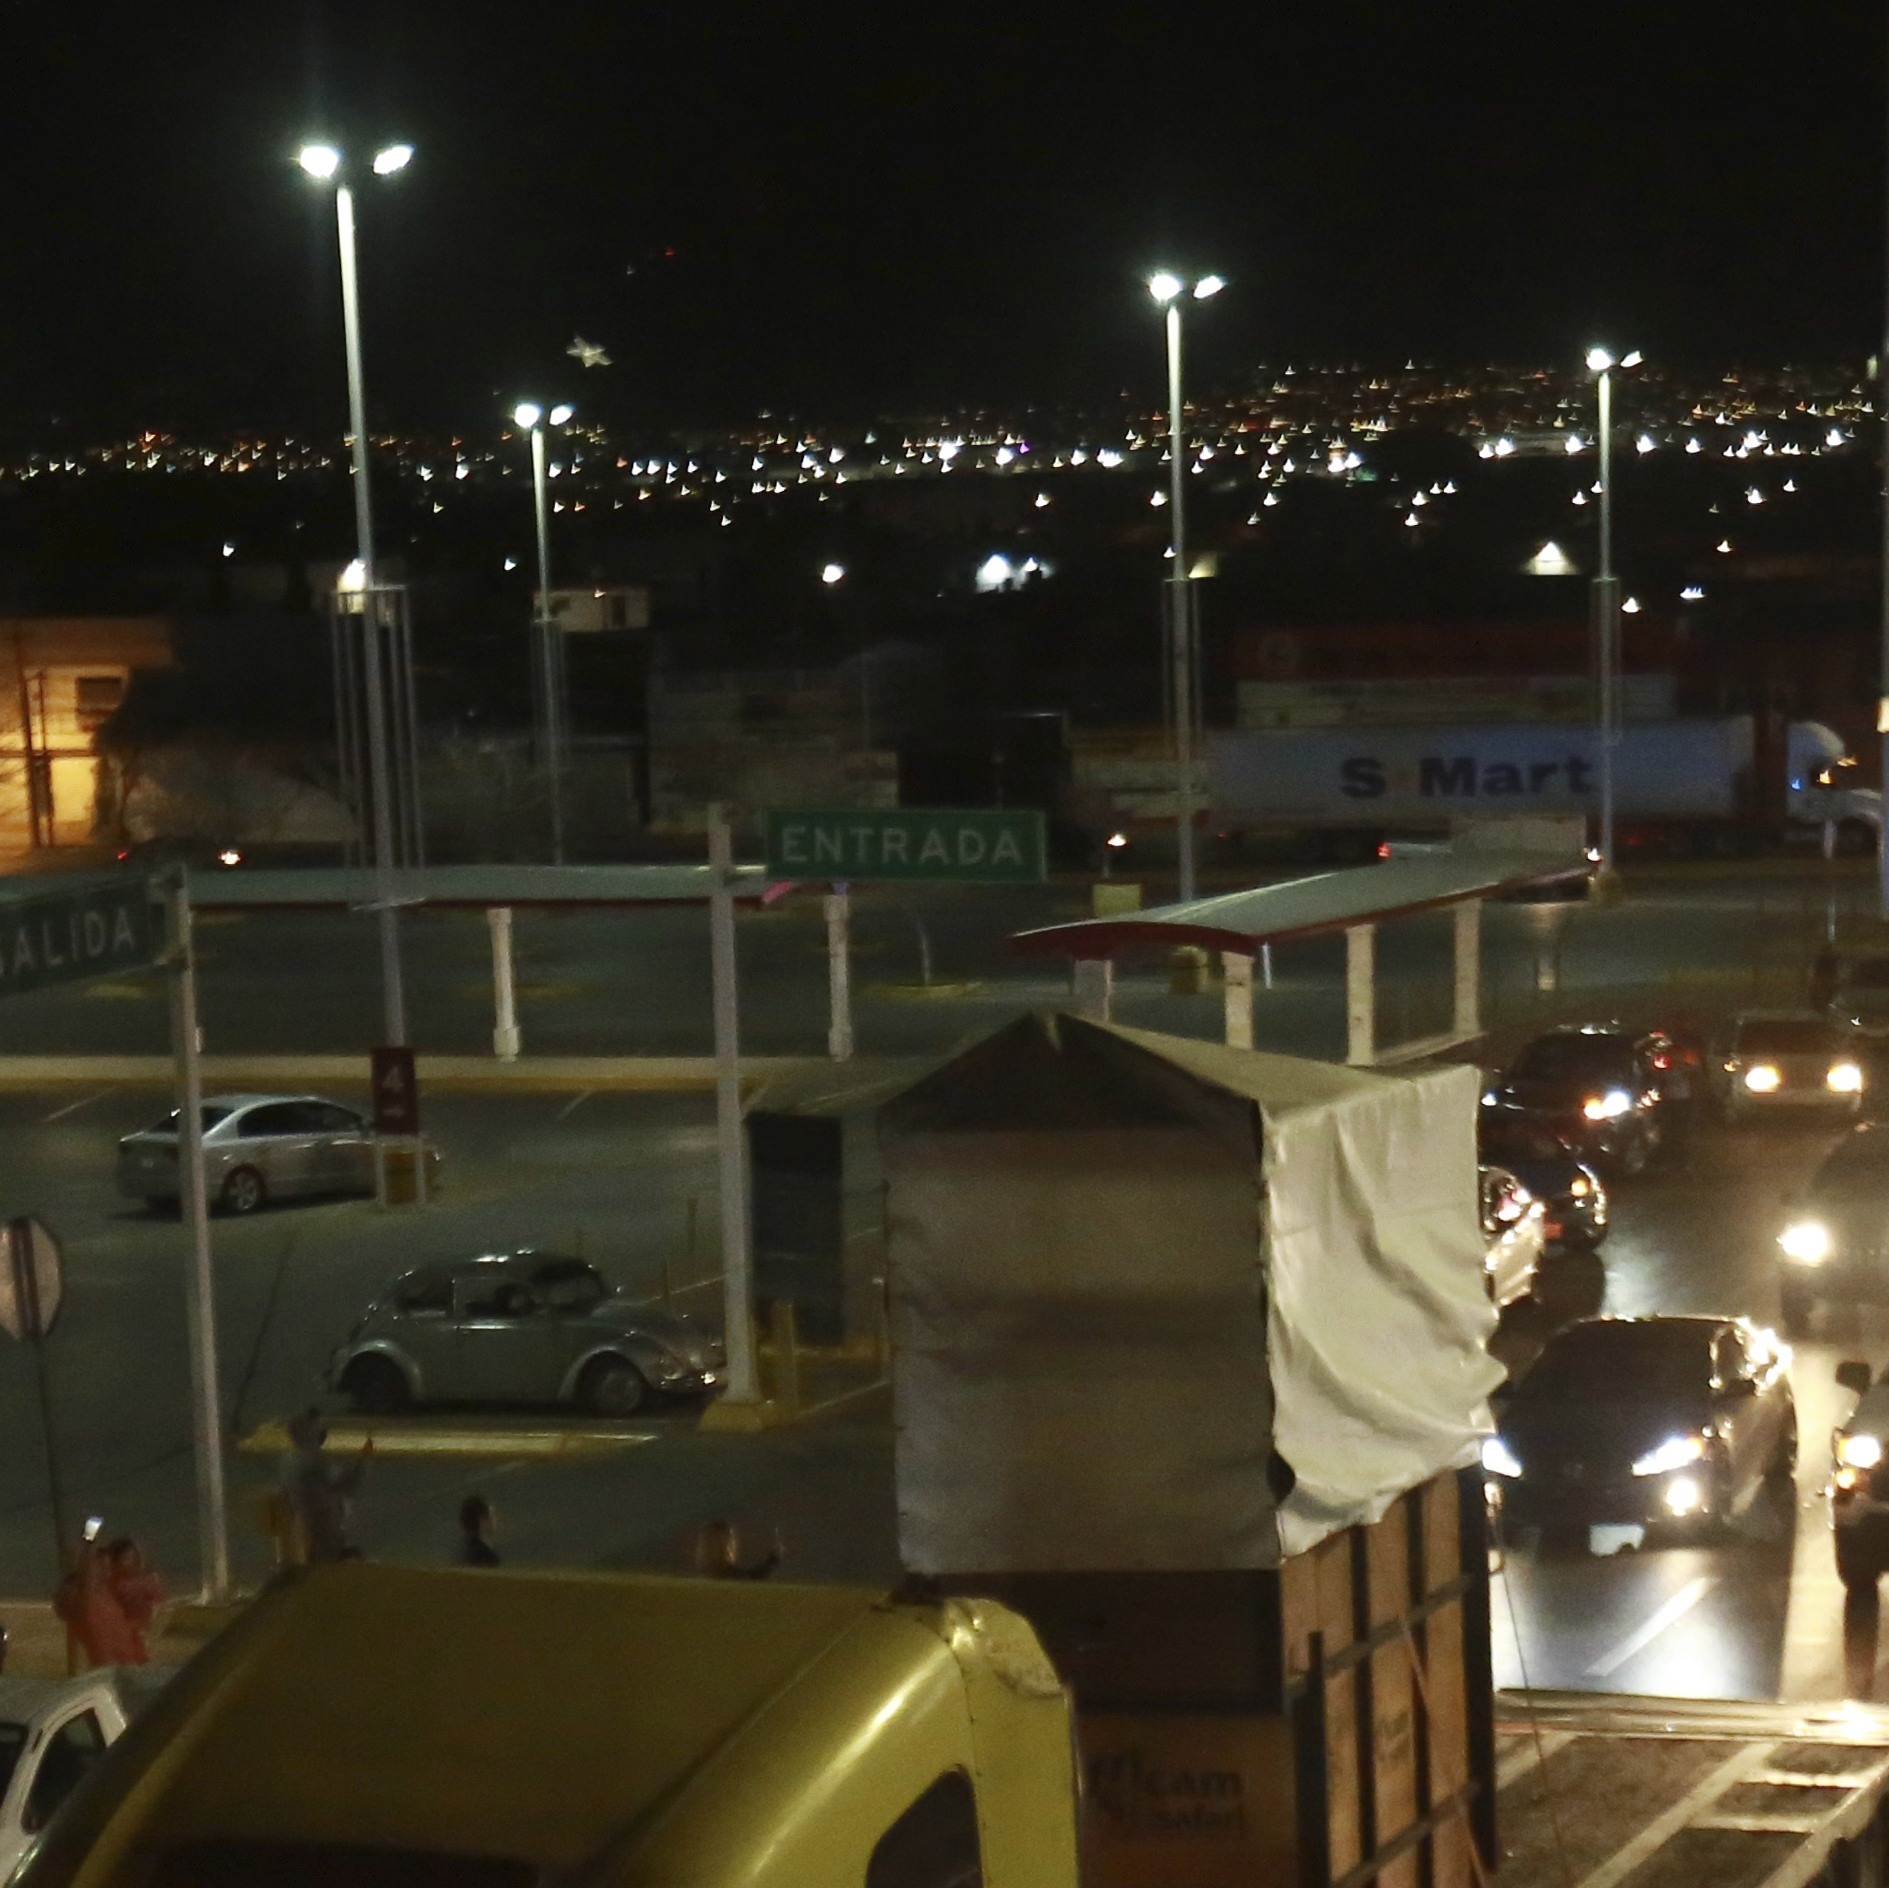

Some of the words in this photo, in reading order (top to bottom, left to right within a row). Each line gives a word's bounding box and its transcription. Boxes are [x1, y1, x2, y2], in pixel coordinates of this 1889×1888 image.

[1341, 756, 1386, 798] S
[1419, 756, 1591, 797] Mart
[781, 825, 1023, 866] ENTRADA
[382, 1064, 405, 1093] 4
